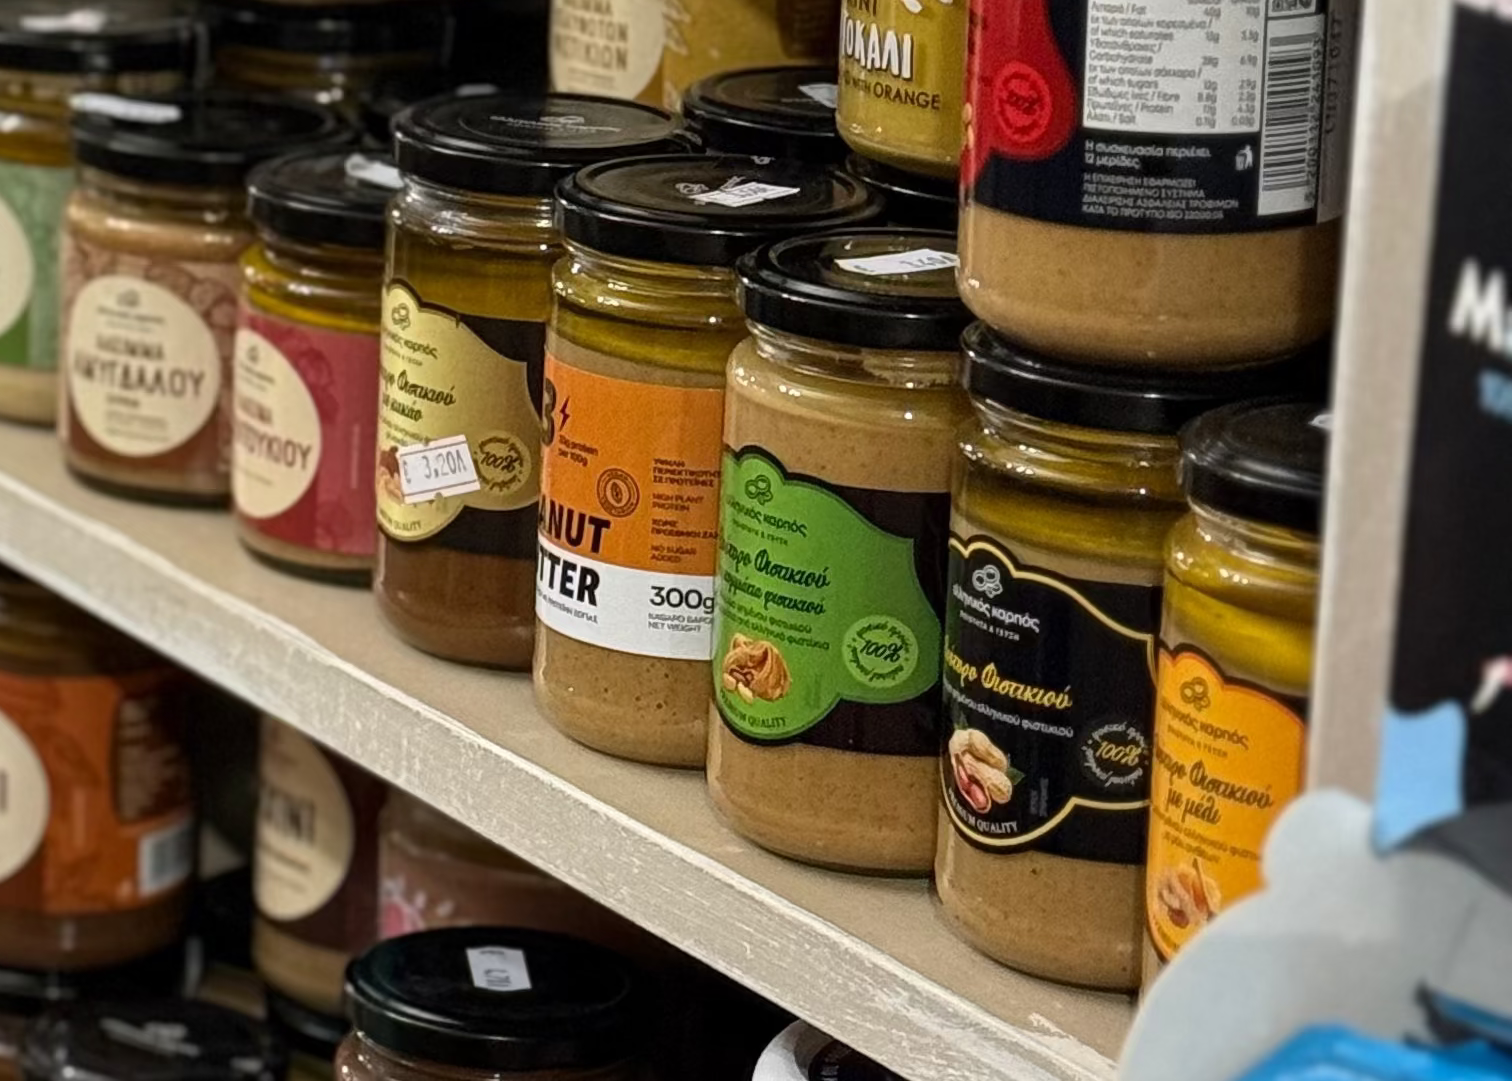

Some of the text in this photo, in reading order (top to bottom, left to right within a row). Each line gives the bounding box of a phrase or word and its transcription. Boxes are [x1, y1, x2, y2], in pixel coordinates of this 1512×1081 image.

[873, 81, 941, 111] ORANGE
[539, 494, 611, 554] ANUT
[539, 545, 600, 607] TTER
[650, 585, 715, 614] 300g
[648, 621, 702, 633] NET WEIGHT
[991, 605, 1040, 633] καρπός
[860, 640, 904, 663] 100%
[981, 662, 1073, 710] Φιστικιού
[748, 715, 788, 729] QUALITY
[1199, 721, 1249, 750] καρπός
[1095, 741, 1142, 767] 100%
[1181, 794, 1222, 825] μέλι
[977, 820, 1018, 834] QUALITY
